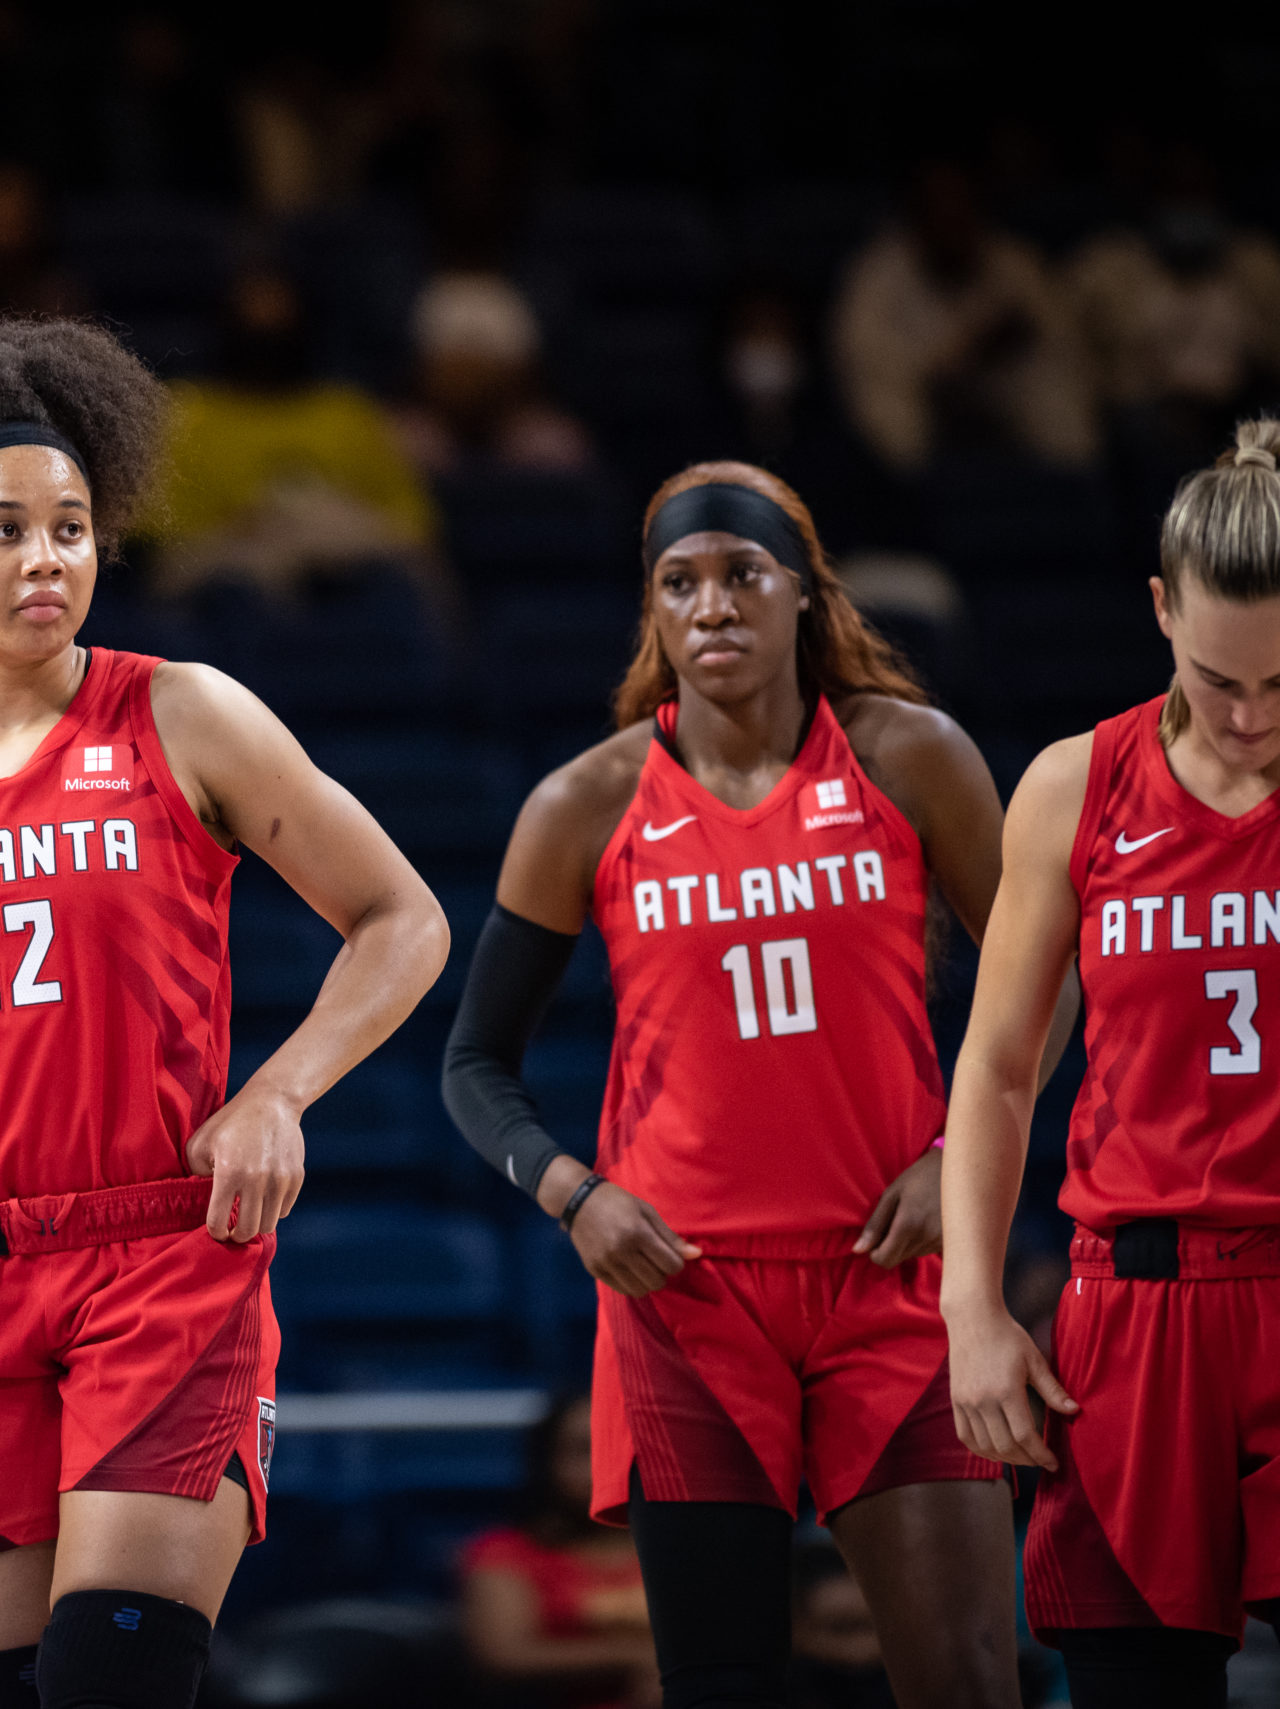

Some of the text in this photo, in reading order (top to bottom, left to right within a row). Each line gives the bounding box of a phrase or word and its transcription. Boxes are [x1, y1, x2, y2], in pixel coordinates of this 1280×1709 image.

[64, 777, 131, 792] Microsoft
[633, 849, 887, 934] ATLANTA
[1101, 890, 1280, 956] ATLAN
[721, 937, 818, 1040] 10
[1204, 969, 1261, 1075] 3
